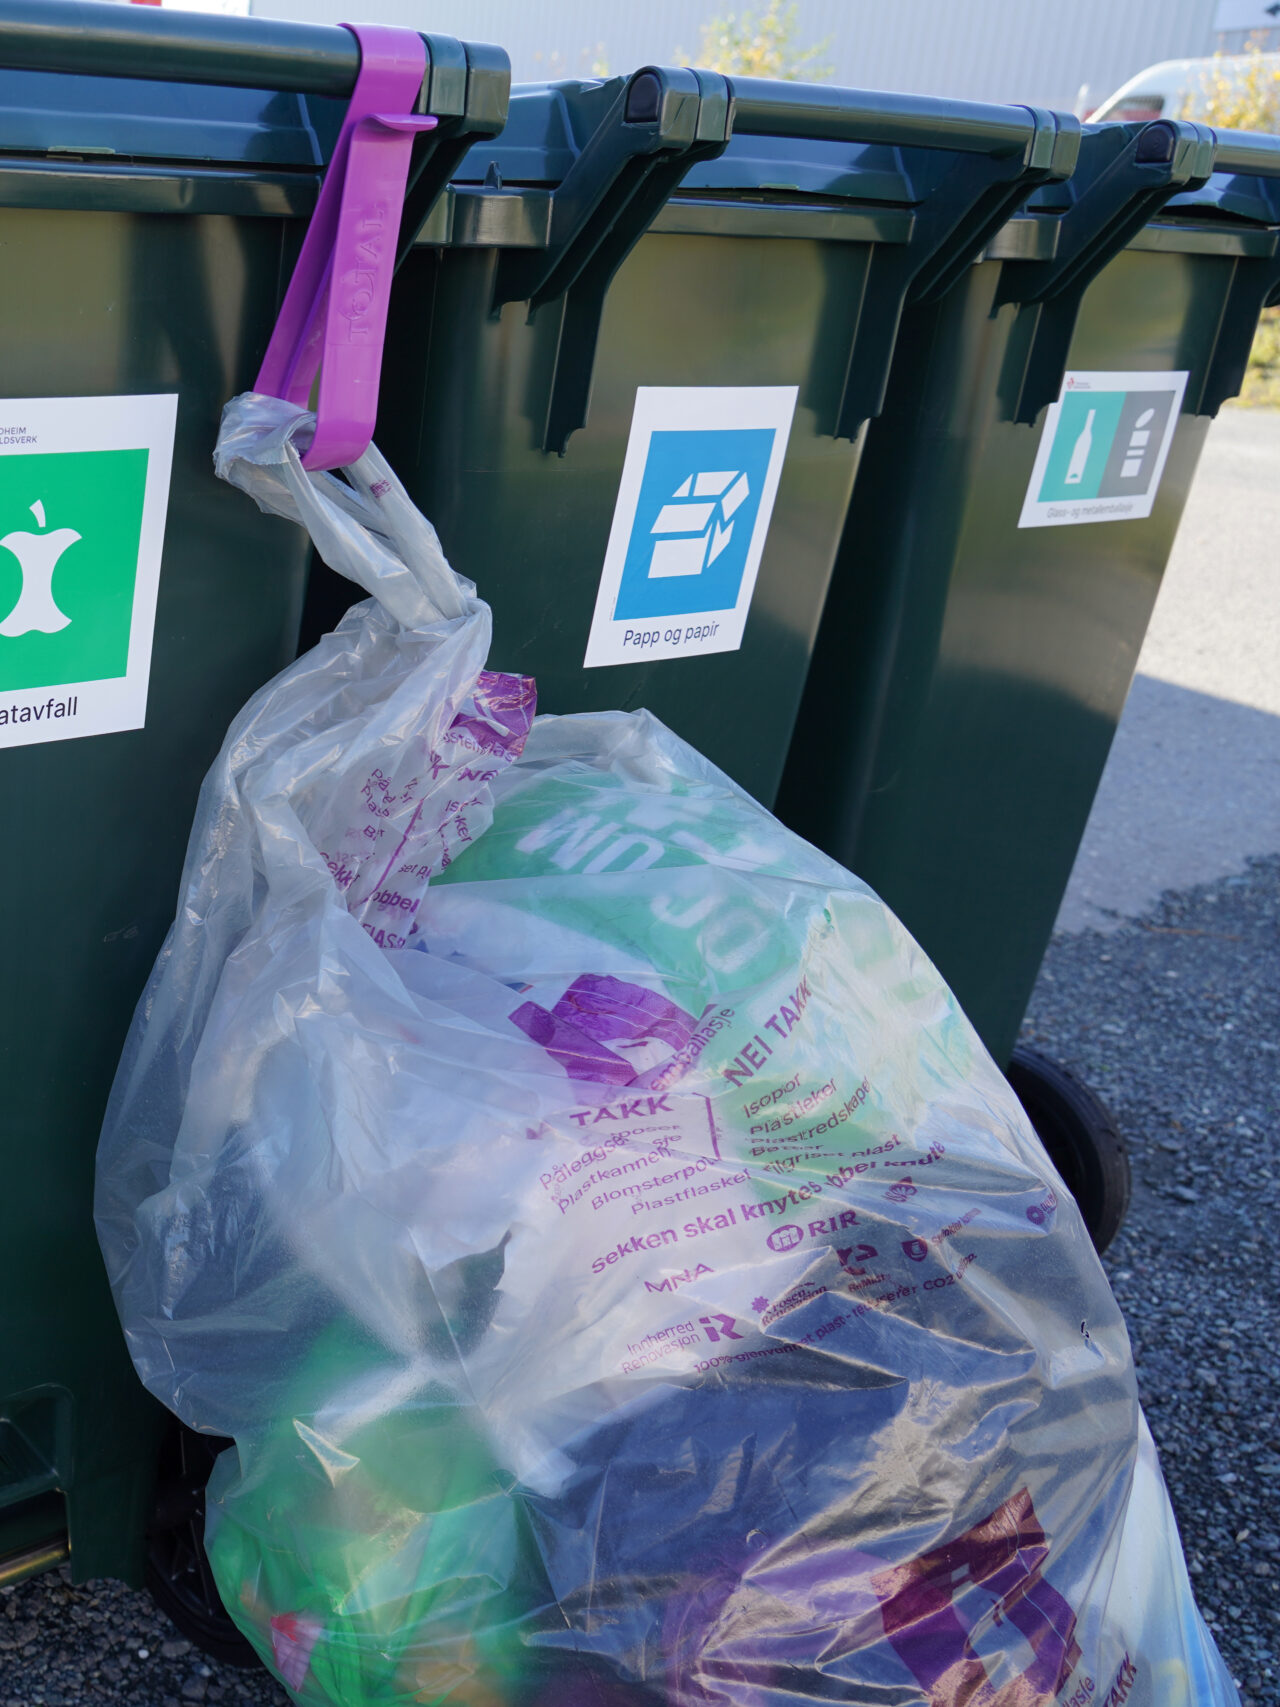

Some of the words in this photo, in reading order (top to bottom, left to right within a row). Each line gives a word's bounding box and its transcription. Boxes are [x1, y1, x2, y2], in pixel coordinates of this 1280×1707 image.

[623, 629, 661, 649] Papp
[664, 627, 682, 646] og
[683, 620, 720, 644] papir
[722, 1034, 773, 1088] NEI
[764, 973, 812, 1039] TAKK
[569, 1092, 675, 1127] TAKK
[743, 1072, 802, 1119] Isopor
[591, 1228, 679, 1274] sekken
[683, 1207, 738, 1238] skal
[740, 1180, 823, 1221] knytes
[807, 1209, 861, 1238] RIR
[815, 1314, 846, 1342] plast
[923, 1274, 956, 1291] CO2
[622, 1333, 702, 1375] Renovasjon
[626, 1320, 695, 1356] Innherred
